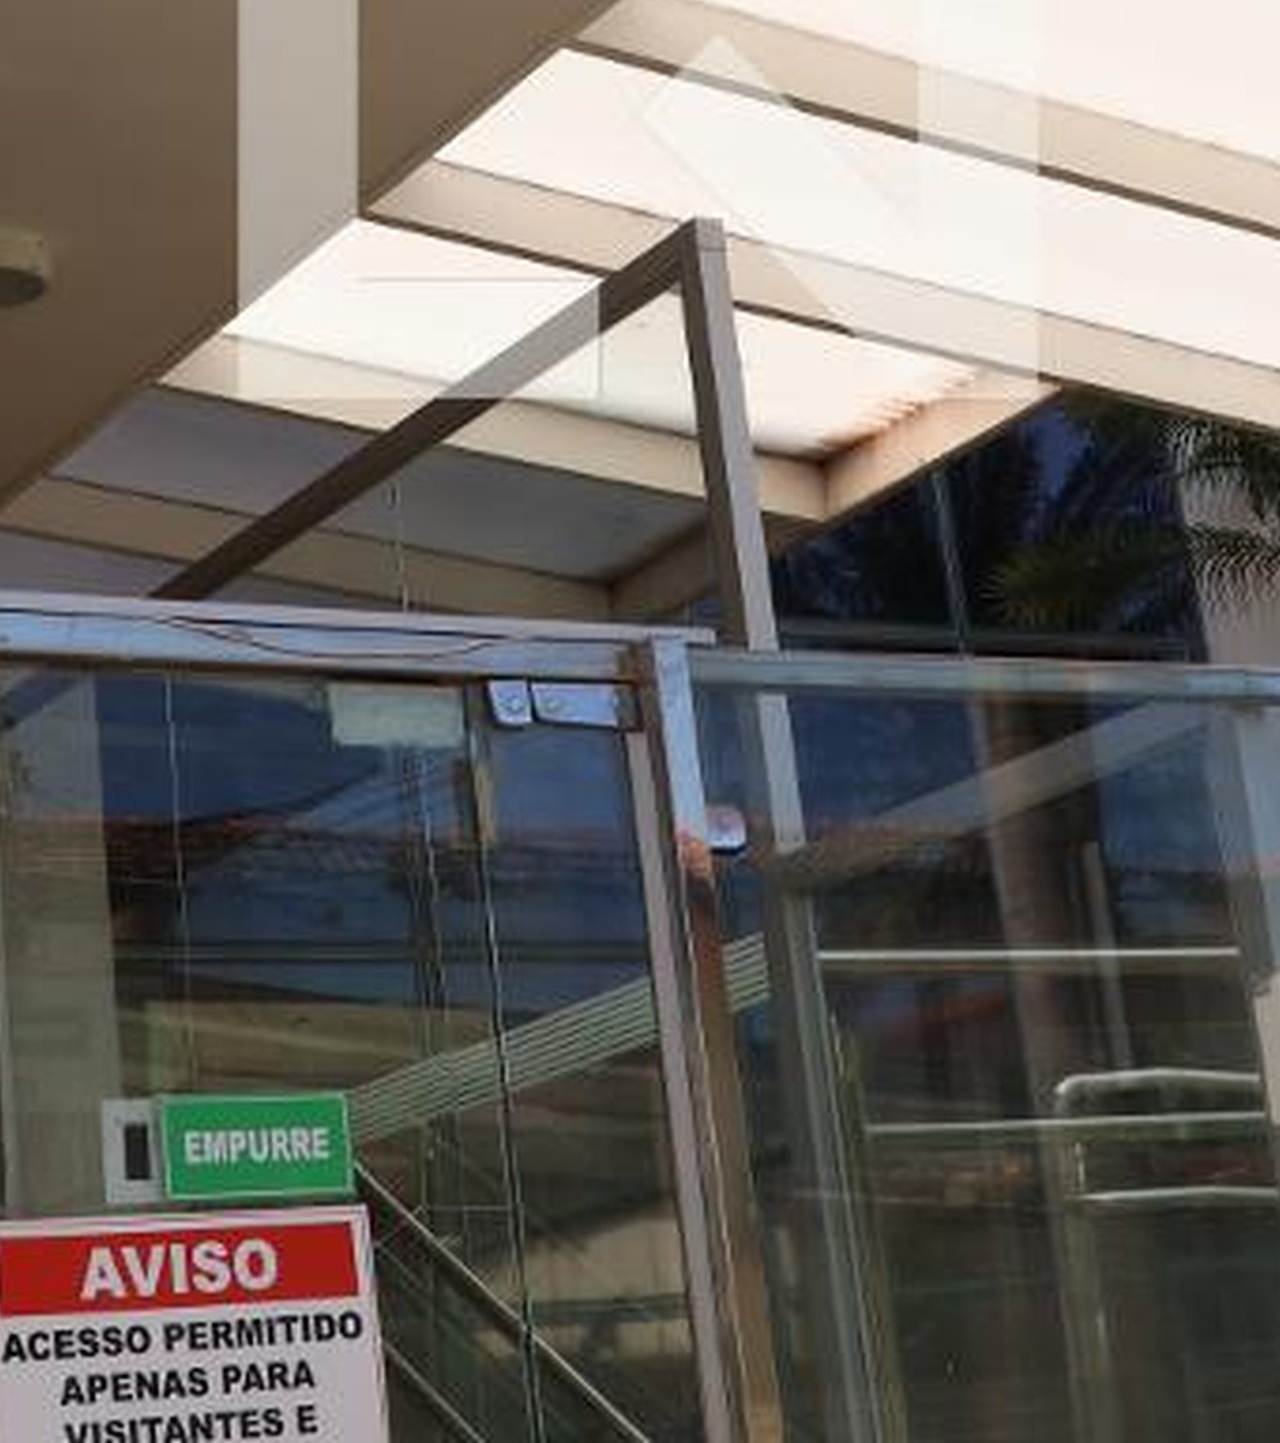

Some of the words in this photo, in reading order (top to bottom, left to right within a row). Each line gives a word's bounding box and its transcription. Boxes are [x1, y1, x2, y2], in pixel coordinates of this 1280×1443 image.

[184, 1126, 330, 1165] EMPURRE
[80, 1238, 278, 1301] AVISO
[1, 1324, 151, 1363] ACESSO
[165, 1311, 363, 1353] PERMITIDO
[60, 1370, 209, 1406] APENAS
[222, 1361, 315, 1393] PARA
[64, 1410, 284, 1443] VISITANTES
[297, 1405, 318, 1433] E
